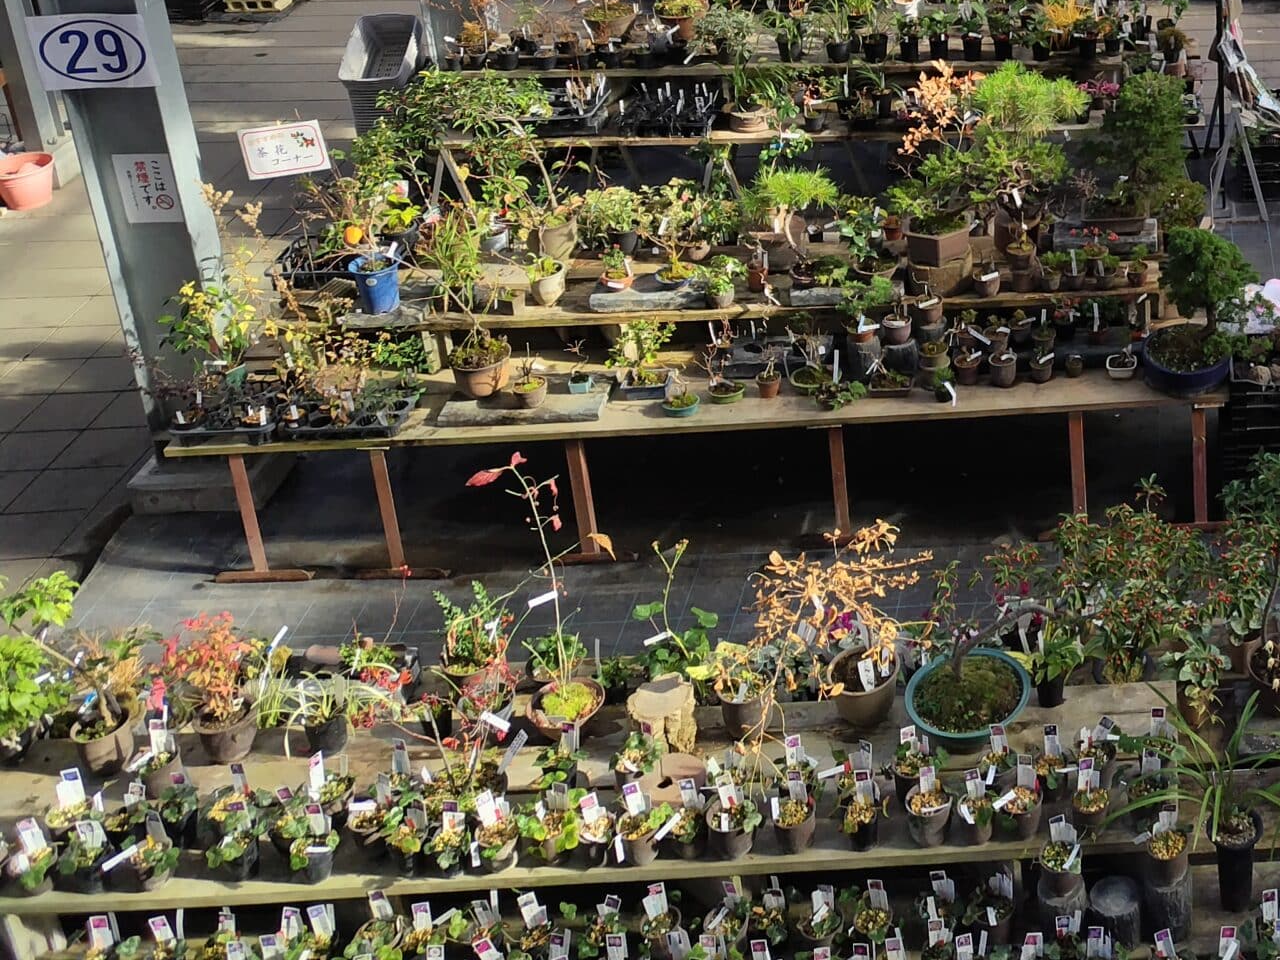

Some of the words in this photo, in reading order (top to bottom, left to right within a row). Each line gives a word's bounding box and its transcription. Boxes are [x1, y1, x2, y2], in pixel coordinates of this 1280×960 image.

[59, 29, 129, 74] 29
[150, 160, 168, 192] ここは
[271, 154, 313, 166] コーナー
